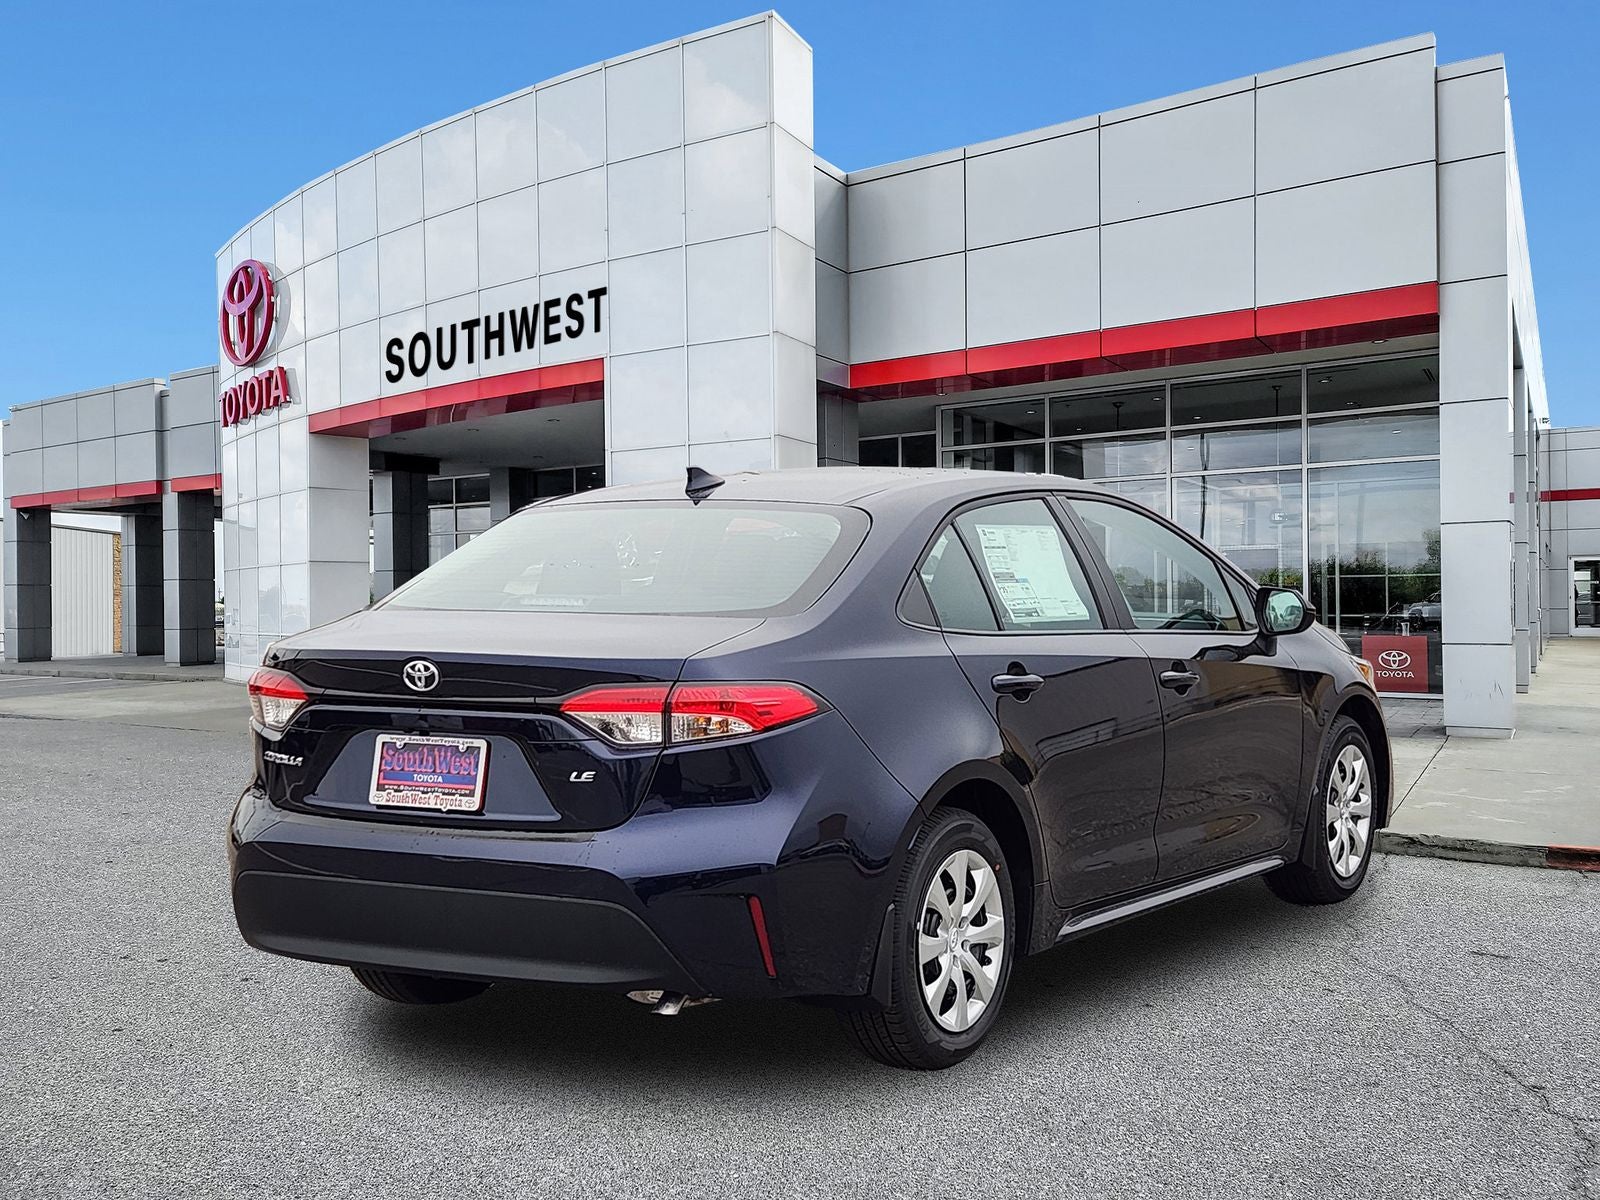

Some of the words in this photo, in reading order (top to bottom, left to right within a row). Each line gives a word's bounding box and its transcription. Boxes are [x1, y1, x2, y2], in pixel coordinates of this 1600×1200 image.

[385, 286, 608, 383] SOUTHWEST
[219, 366, 291, 428] TOYOTA
[1376, 670, 1415, 678] TOYOTA
[413, 774, 443, 783] TOYOTA
[569, 771, 597, 782] LE
[385, 791, 432, 806] SouthWest
[433, 795, 464, 810] Toyota
